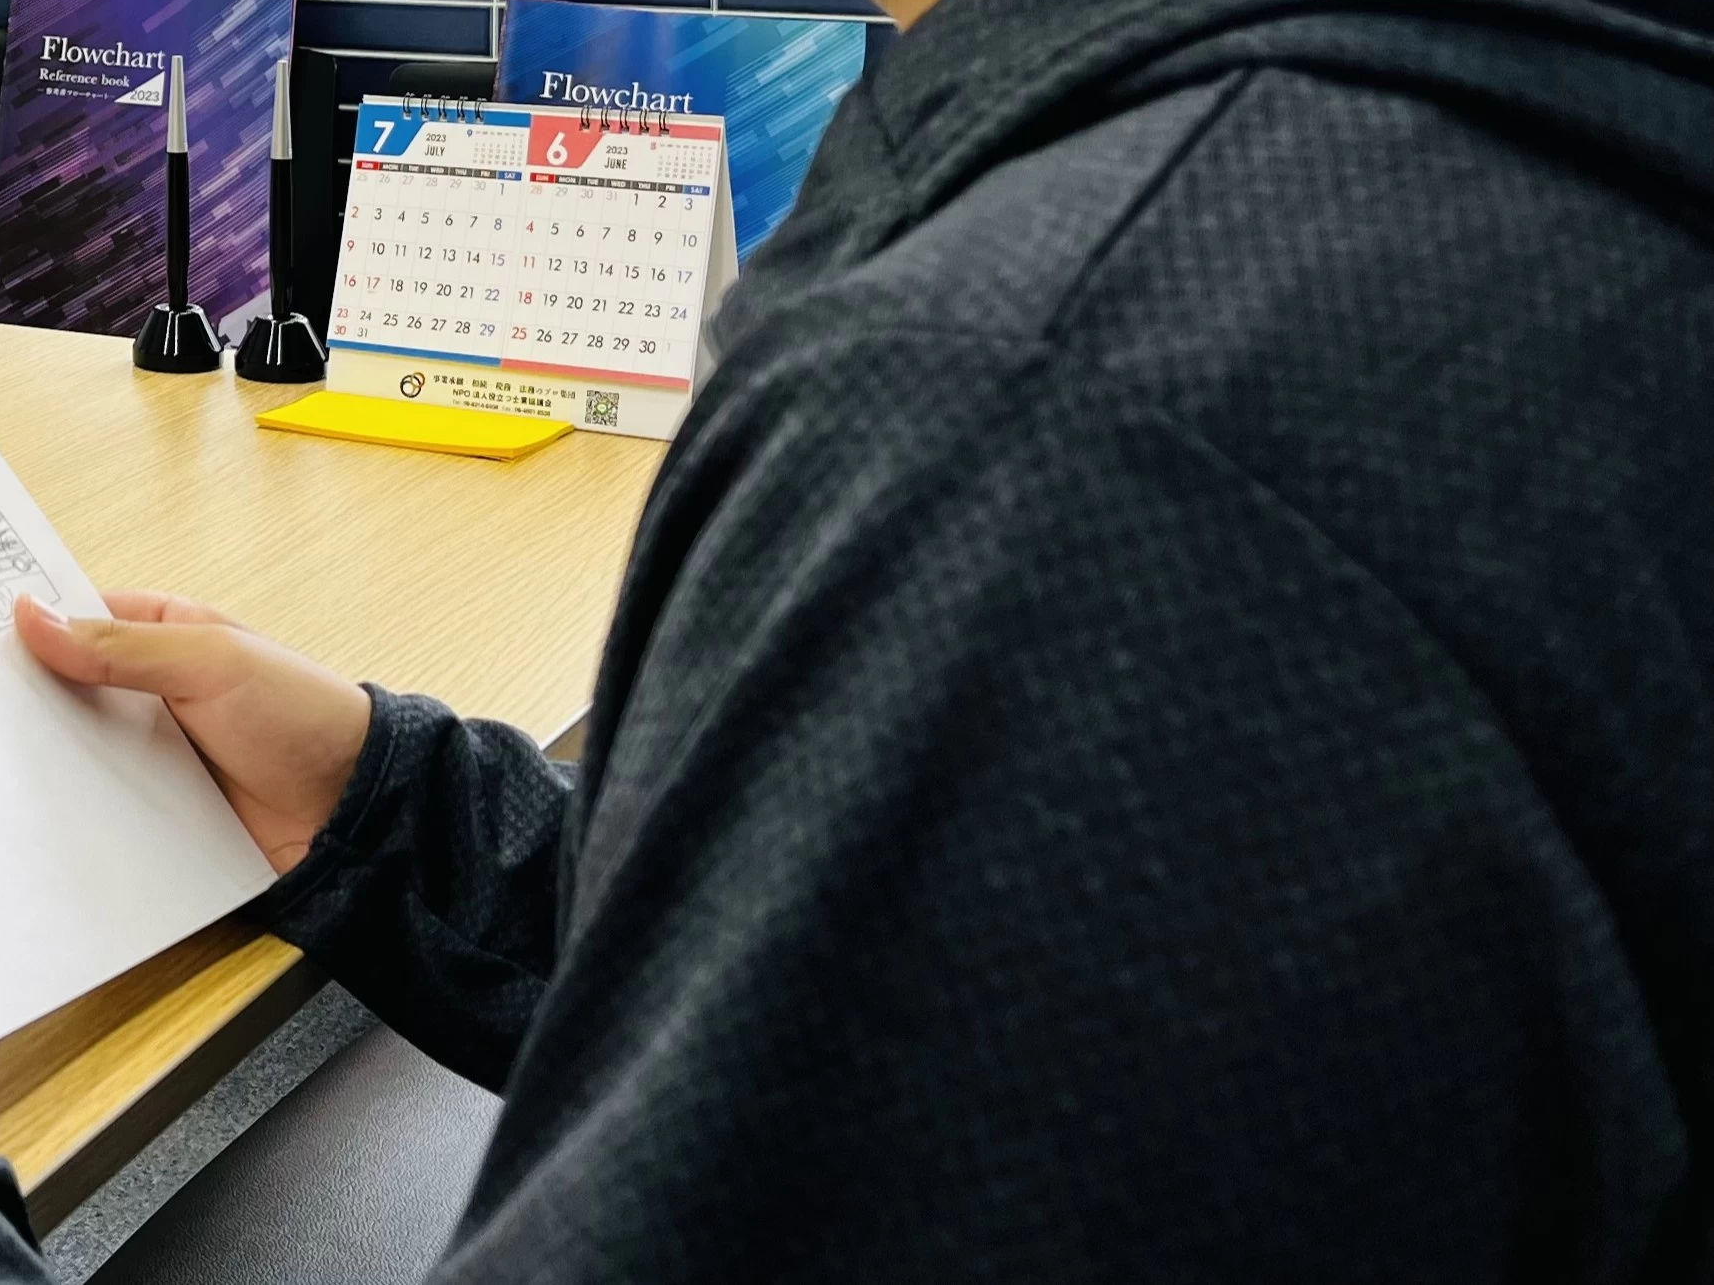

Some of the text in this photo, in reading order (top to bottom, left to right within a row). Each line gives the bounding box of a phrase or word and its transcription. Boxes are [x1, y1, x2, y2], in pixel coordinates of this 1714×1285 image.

[40, 35, 166, 70] Flowchart
[39, 68, 130, 87] Reference book
[130, 89, 160, 102] 2023
[539, 71, 694, 114] Flowchart
[374, 121, 394, 153] 7
[426, 134, 446, 142] 2023
[547, 132, 568, 165] 6
[425, 147, 445, 156] JULY
[606, 146, 628, 155] 2023
[604, 158, 627, 169] JUNE
[357, 172, 504, 194] 25 26 27 28 29 30 1
[530, 185, 693, 210] 28 29 30 31 1 2 3
[351, 206, 502, 230] 2 3 4 5 6 7 8
[526, 221, 697, 247] 4 5 6 7 8 9 10
[347, 240, 505, 266] 9 10 11 12 13 14 15
[524, 256, 692, 283] 11 12 13 14 15 16 17
[344, 274, 500, 301] 16 17 18 19 20 21 22
[519, 291, 687, 320] 18 19 20 21 22 23 24
[335, 326, 367, 338] 30 31
[337, 308, 495, 336] 23 24 25 26 27 28 29
[511, 327, 527, 339] 25
[536, 329, 552, 342] 26
[562, 332, 578, 345] 27
[587, 335, 603, 348] 28
[613, 337, 629, 351] 29
[639, 340, 656, 354] 30
[452, 389, 471, 398] NPO
